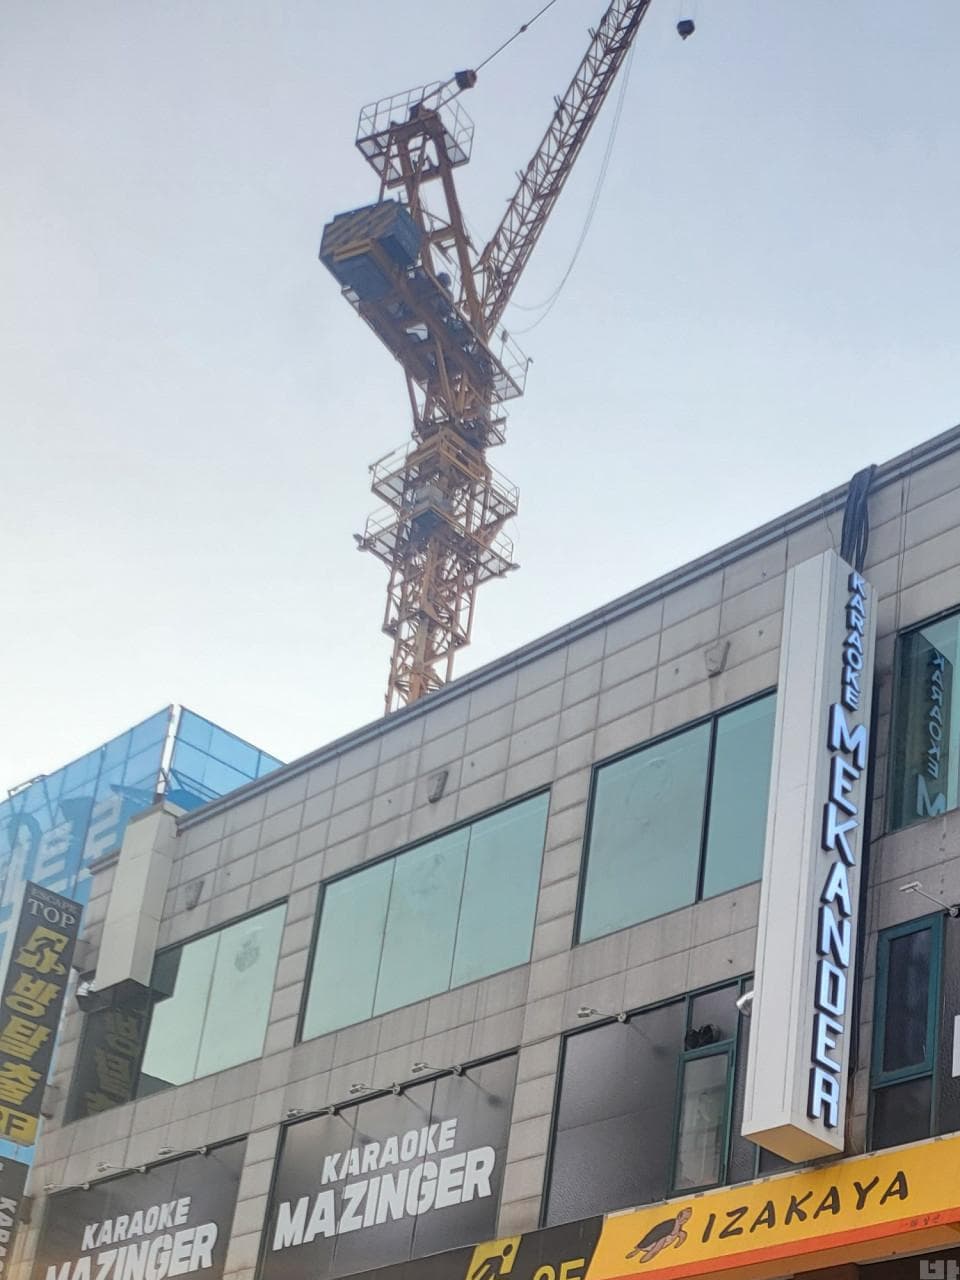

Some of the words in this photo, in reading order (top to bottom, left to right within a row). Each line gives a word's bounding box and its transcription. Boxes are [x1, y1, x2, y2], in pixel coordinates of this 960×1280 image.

[842, 572, 867, 711] KARAOKE
[27, 899, 75, 929] TOP
[807, 703, 868, 1128] MEKANDER
[321, 1118, 457, 1185] KARAOKE
[81, 1196, 192, 1251] KARAOKE
[272, 1145, 495, 1251] MAZINGER
[702, 1171, 909, 1243] IZAKAYA
